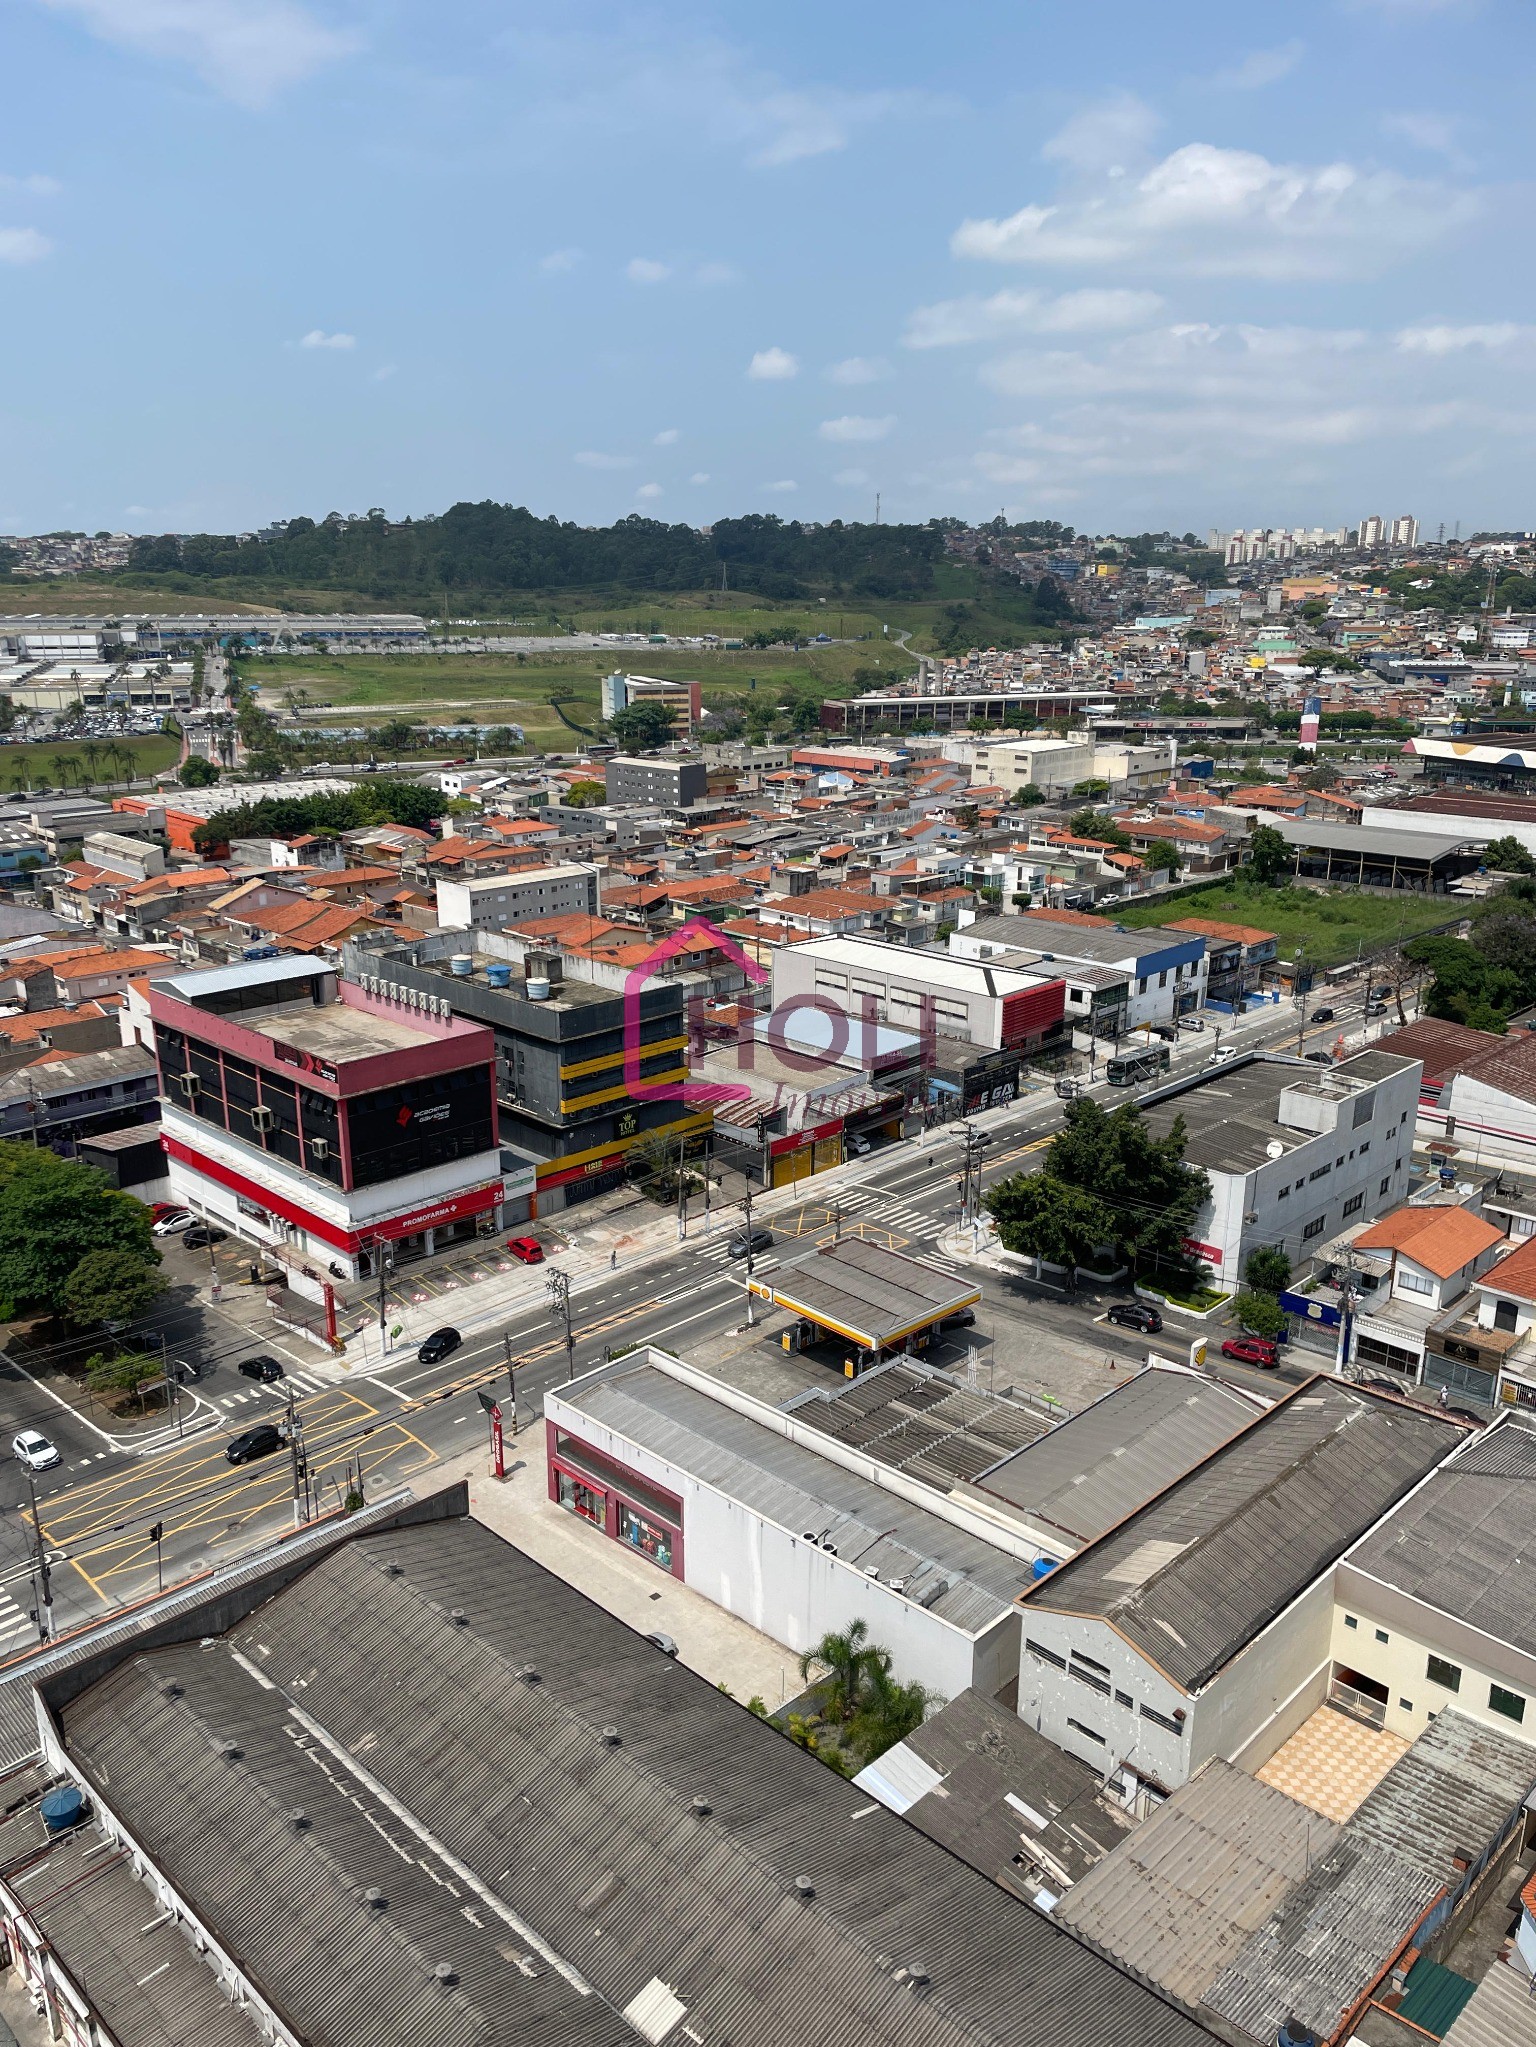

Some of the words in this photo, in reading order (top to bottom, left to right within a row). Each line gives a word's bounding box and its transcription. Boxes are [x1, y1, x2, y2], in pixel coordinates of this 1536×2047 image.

[618, 1119, 637, 1132] TOP
[494, 1190, 503, 1200] 24
[402, 1207, 450, 1228] PROMOFARMA
